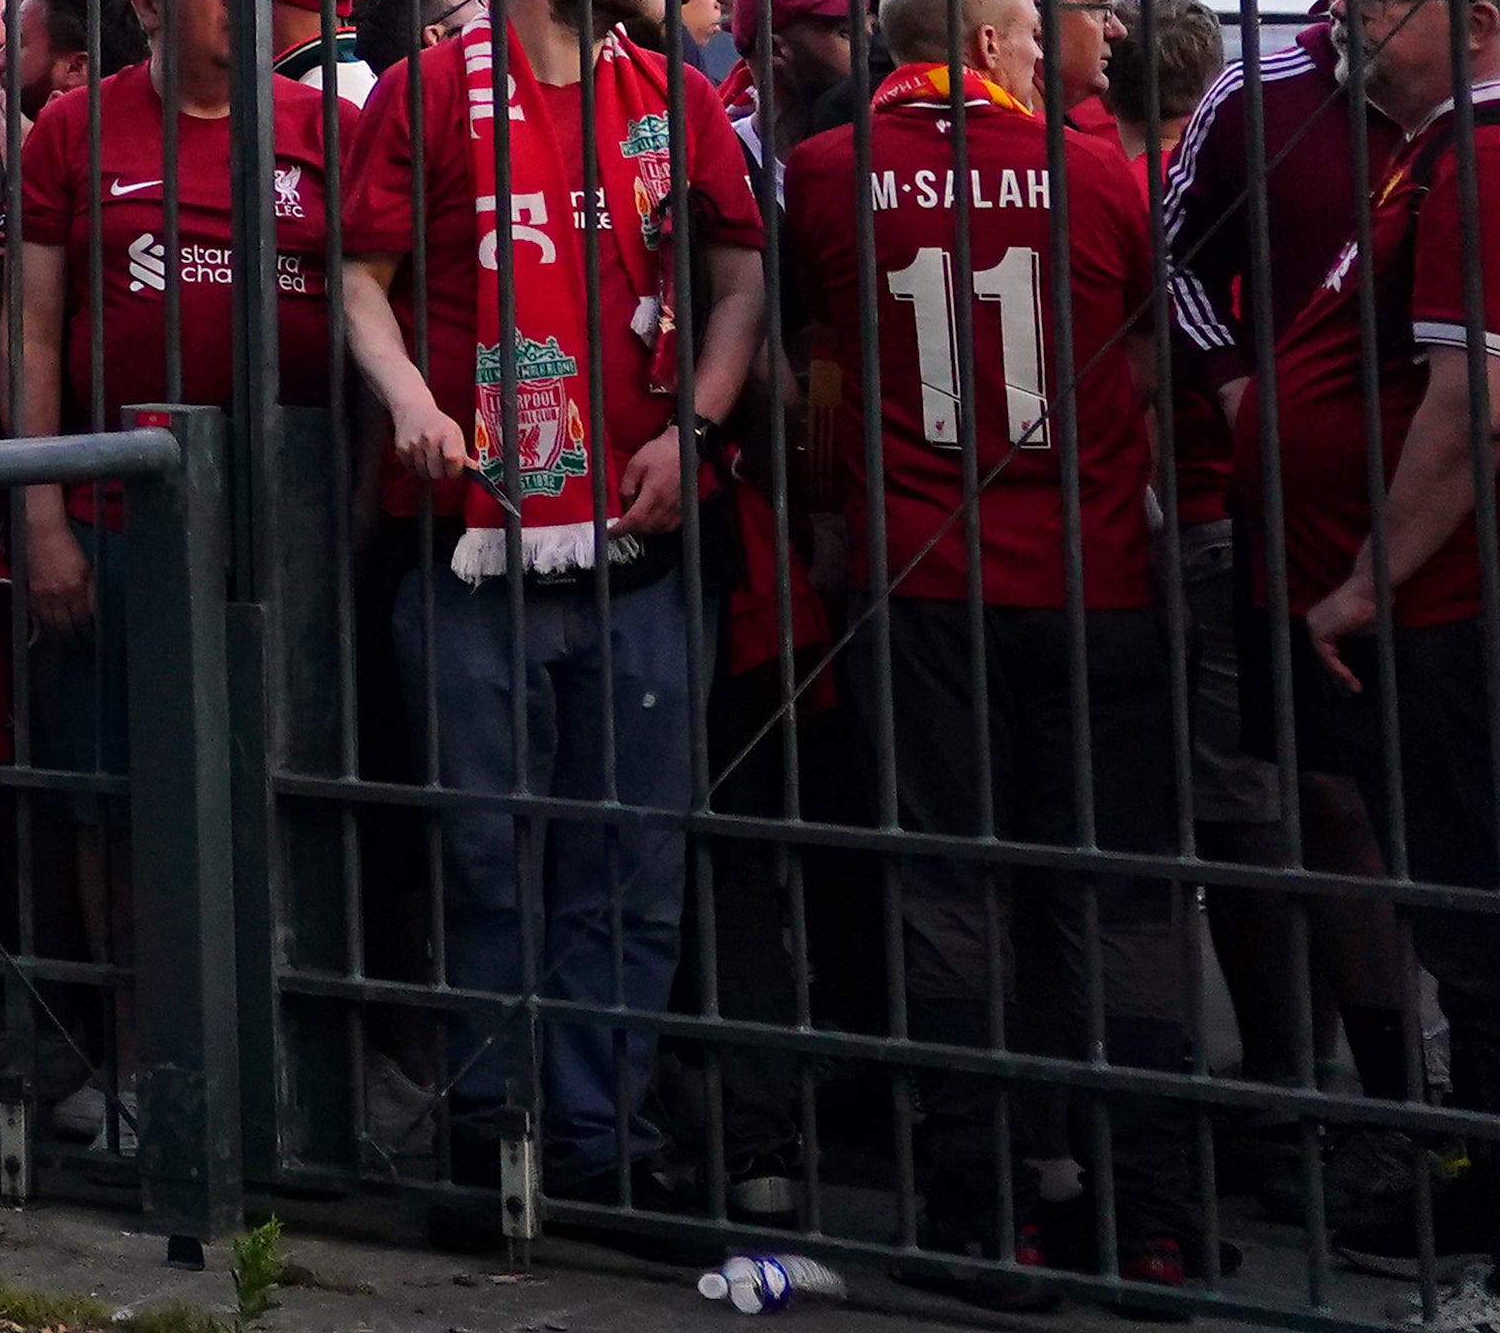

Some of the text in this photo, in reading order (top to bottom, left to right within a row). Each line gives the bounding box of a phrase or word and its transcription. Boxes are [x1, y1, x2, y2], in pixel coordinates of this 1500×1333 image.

[476, 191, 556, 270] FC
[886, 246, 1051, 450] 11
[489, 390, 558, 413] LIRPOOL
